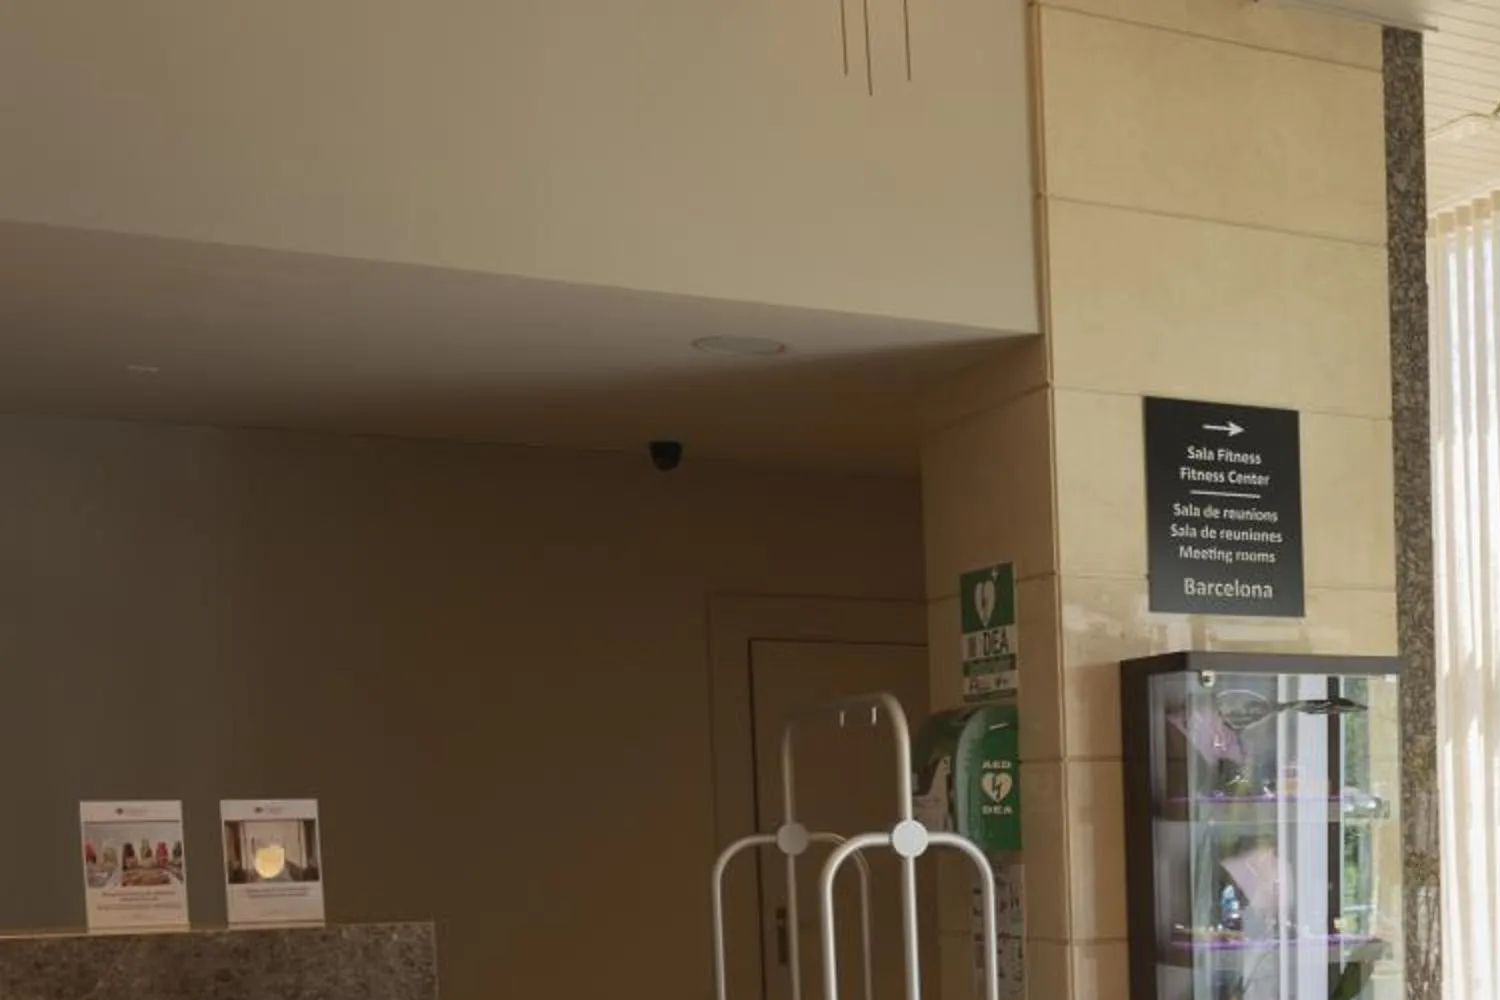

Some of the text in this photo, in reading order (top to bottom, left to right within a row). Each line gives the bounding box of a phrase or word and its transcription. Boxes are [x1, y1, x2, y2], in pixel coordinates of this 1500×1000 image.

[1187, 445, 1262, 465] Sala Fitness
[1180, 466, 1270, 486] Fitness Center
[1173, 503, 1279, 523] Sala de reunions
[1170, 523, 1283, 543] Sala de reuniones
[1179, 545, 1276, 564] Meeting rooms
[1183, 577, 1274, 599] Barcelona
[982, 804, 1013, 815] DEA
